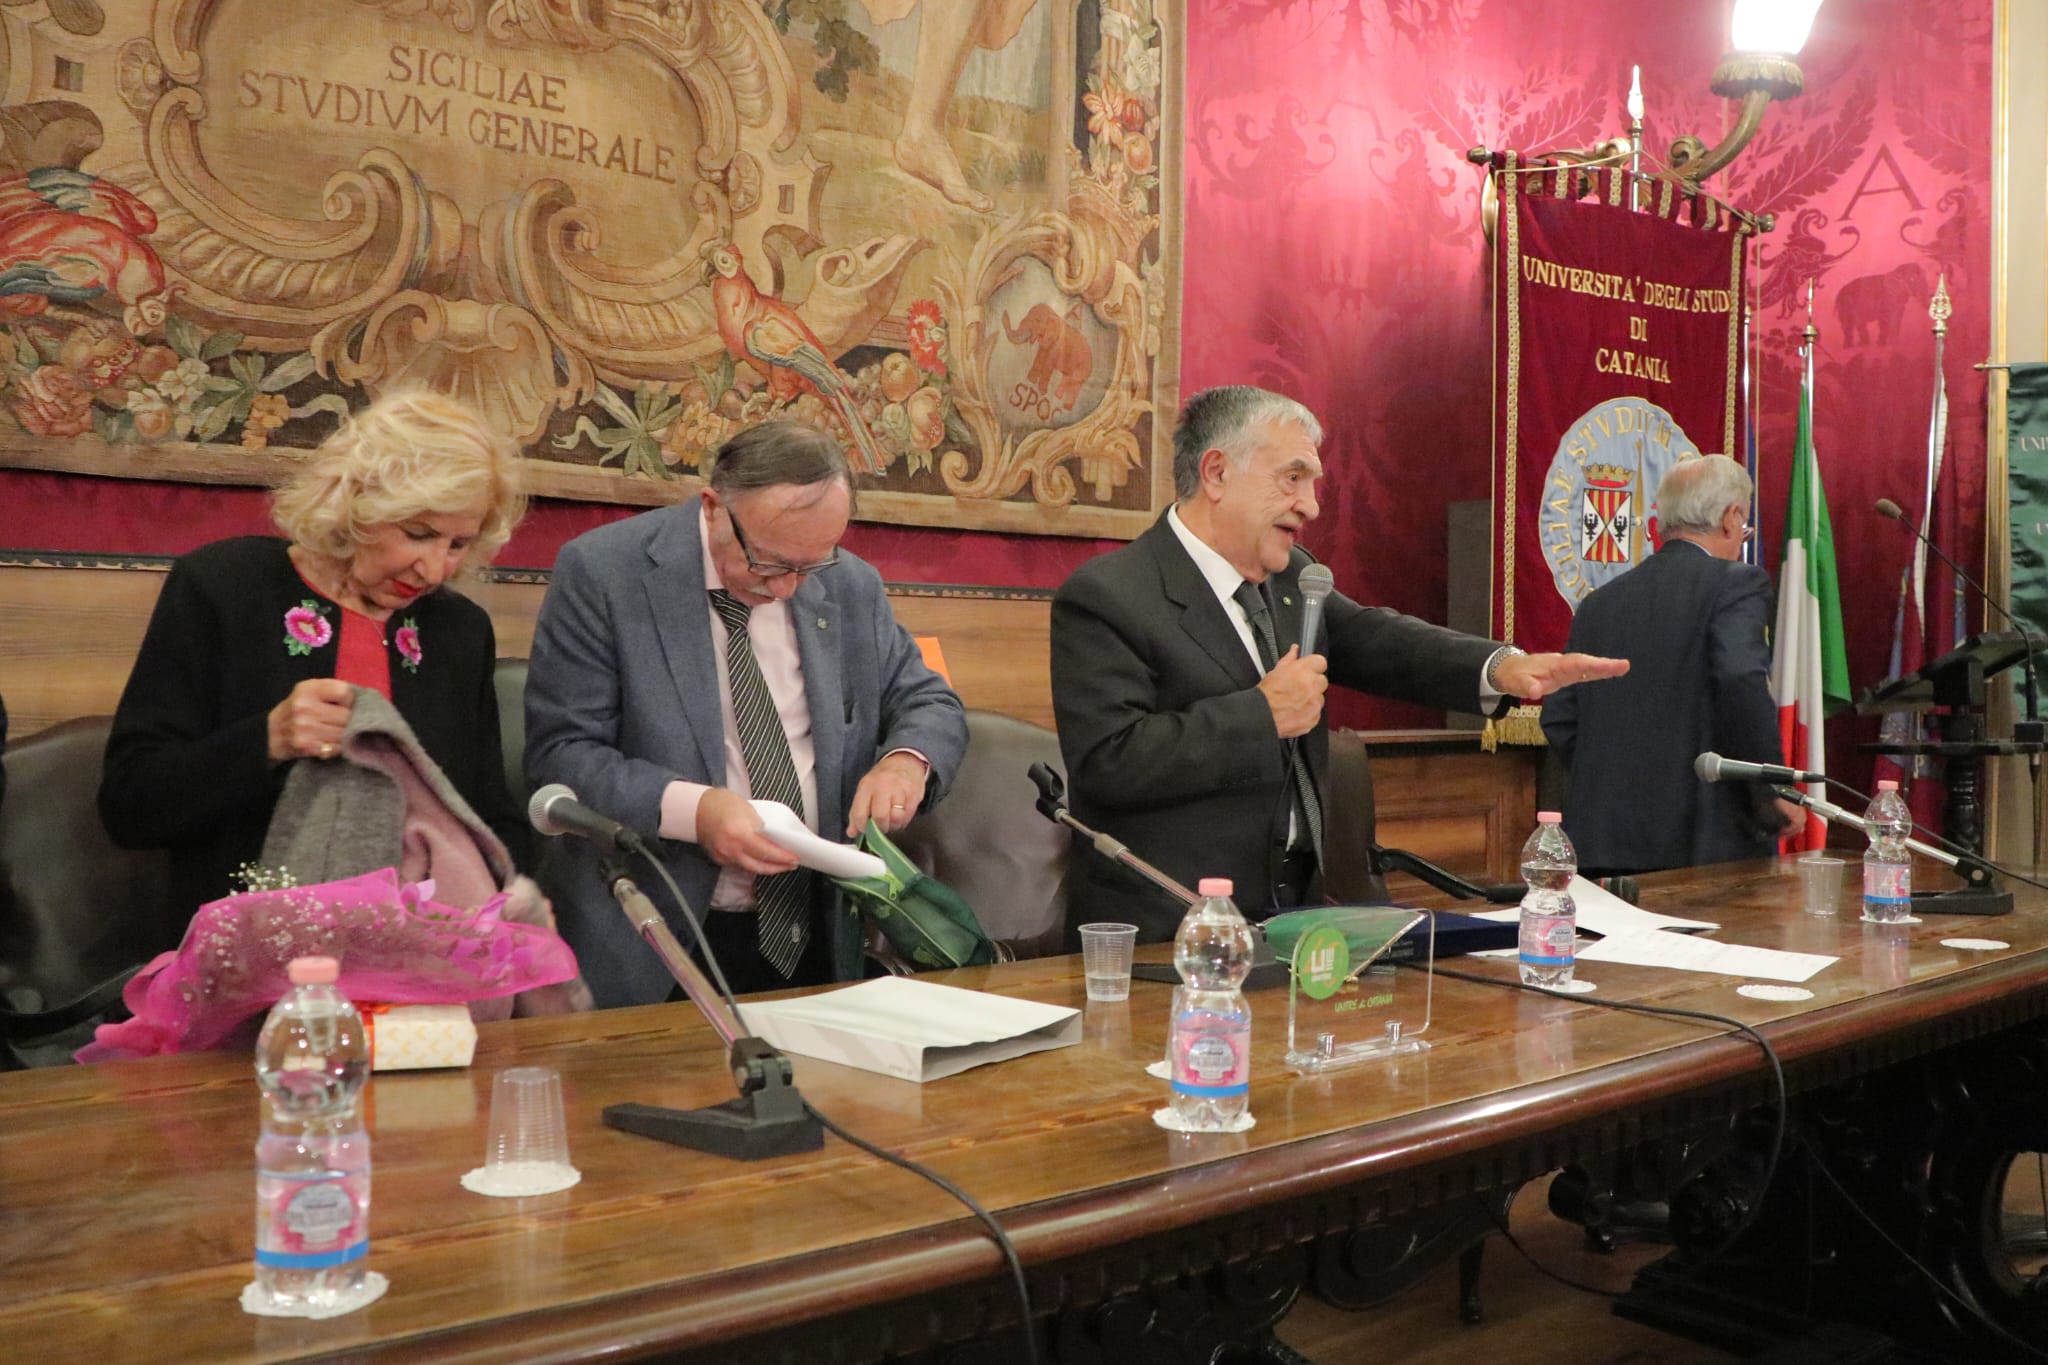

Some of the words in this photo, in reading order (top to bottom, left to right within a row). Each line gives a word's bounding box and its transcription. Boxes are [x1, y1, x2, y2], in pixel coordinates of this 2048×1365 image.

[386, 45, 567, 113] SICILIAE
[237, 69, 450, 136] STVDIVM
[468, 108, 677, 185] GENERALE
[1643, 281, 1691, 312] DEGLI
[1629, 316, 1648, 342] DI
[1595, 347, 1672, 384] CATANIA
